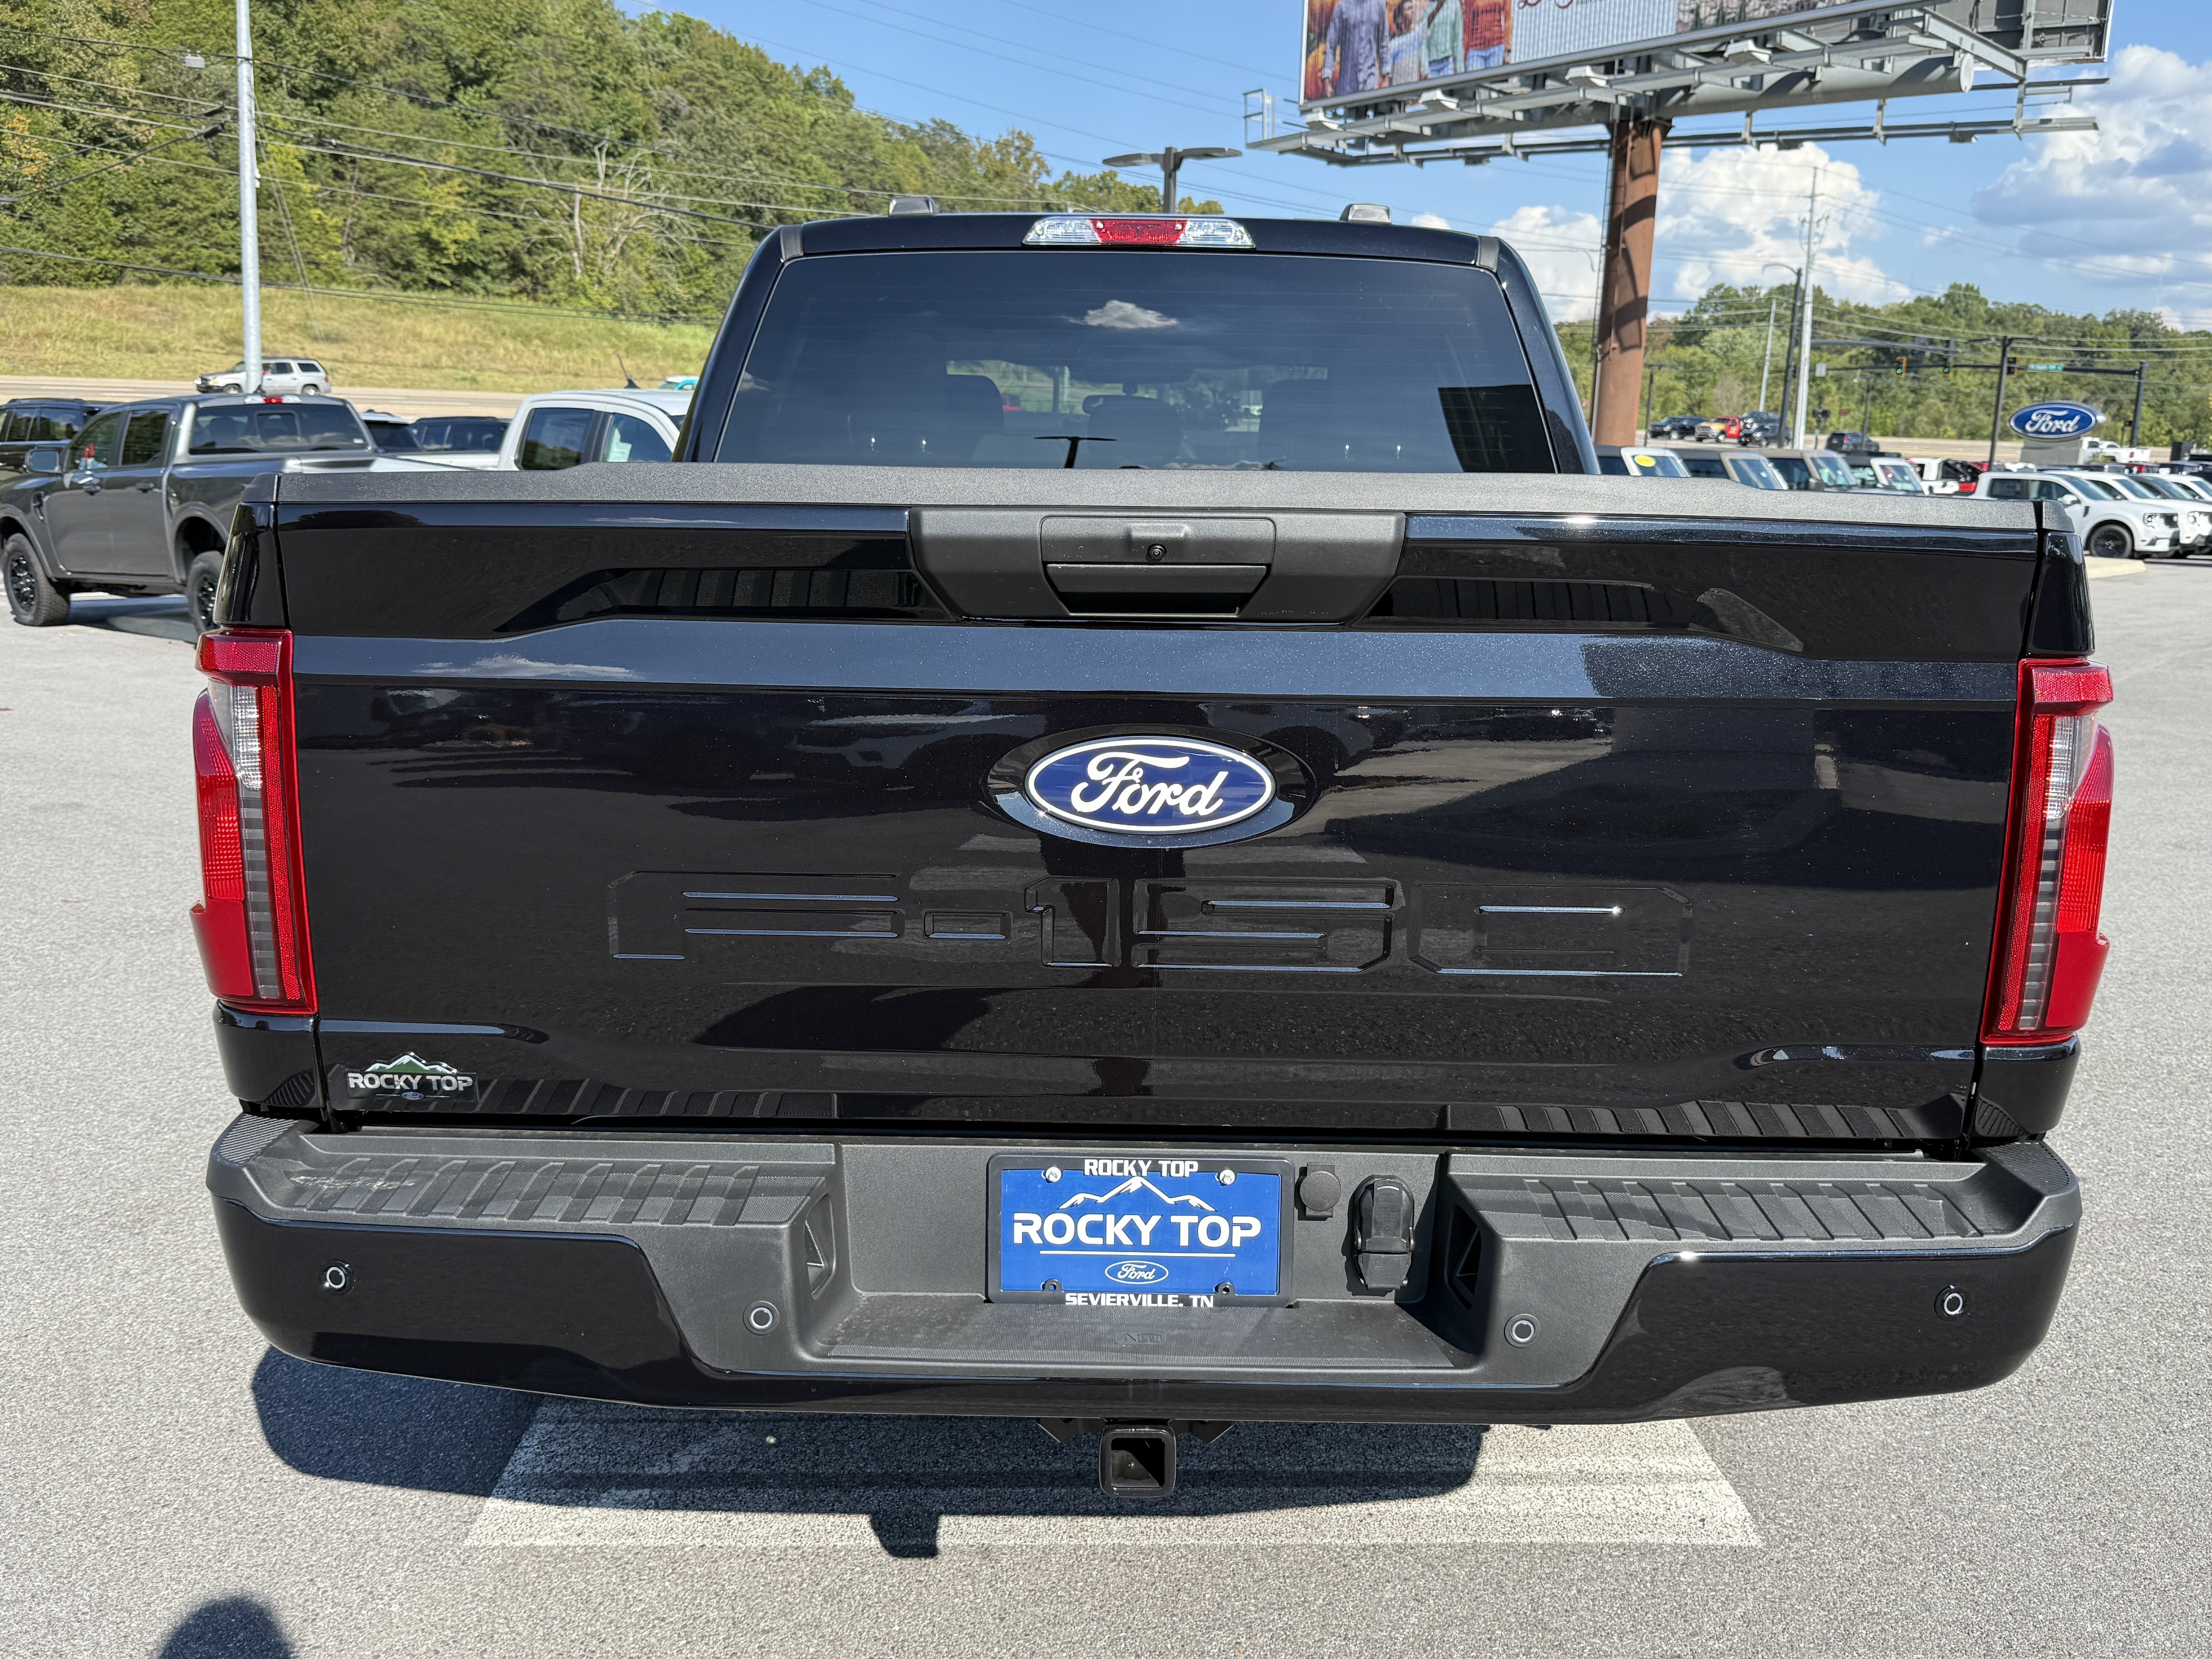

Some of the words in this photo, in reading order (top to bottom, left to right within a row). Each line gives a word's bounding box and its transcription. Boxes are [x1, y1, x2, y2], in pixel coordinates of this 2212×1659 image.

[2025, 409, 2081, 433] Ford
[1070, 751, 1228, 815] Ford
[348, 1073, 422, 1090] ROCKY
[426, 1075, 473, 1091] TOP
[1084, 1159, 1152, 1176] ROCKY
[1158, 1160, 1199, 1177] TOP
[1013, 1213, 1163, 1245] ROCKY
[1170, 1216, 1262, 1247] TOP
[1117, 1264, 1156, 1280] Ford
[1189, 1295, 1214, 1307] TN
